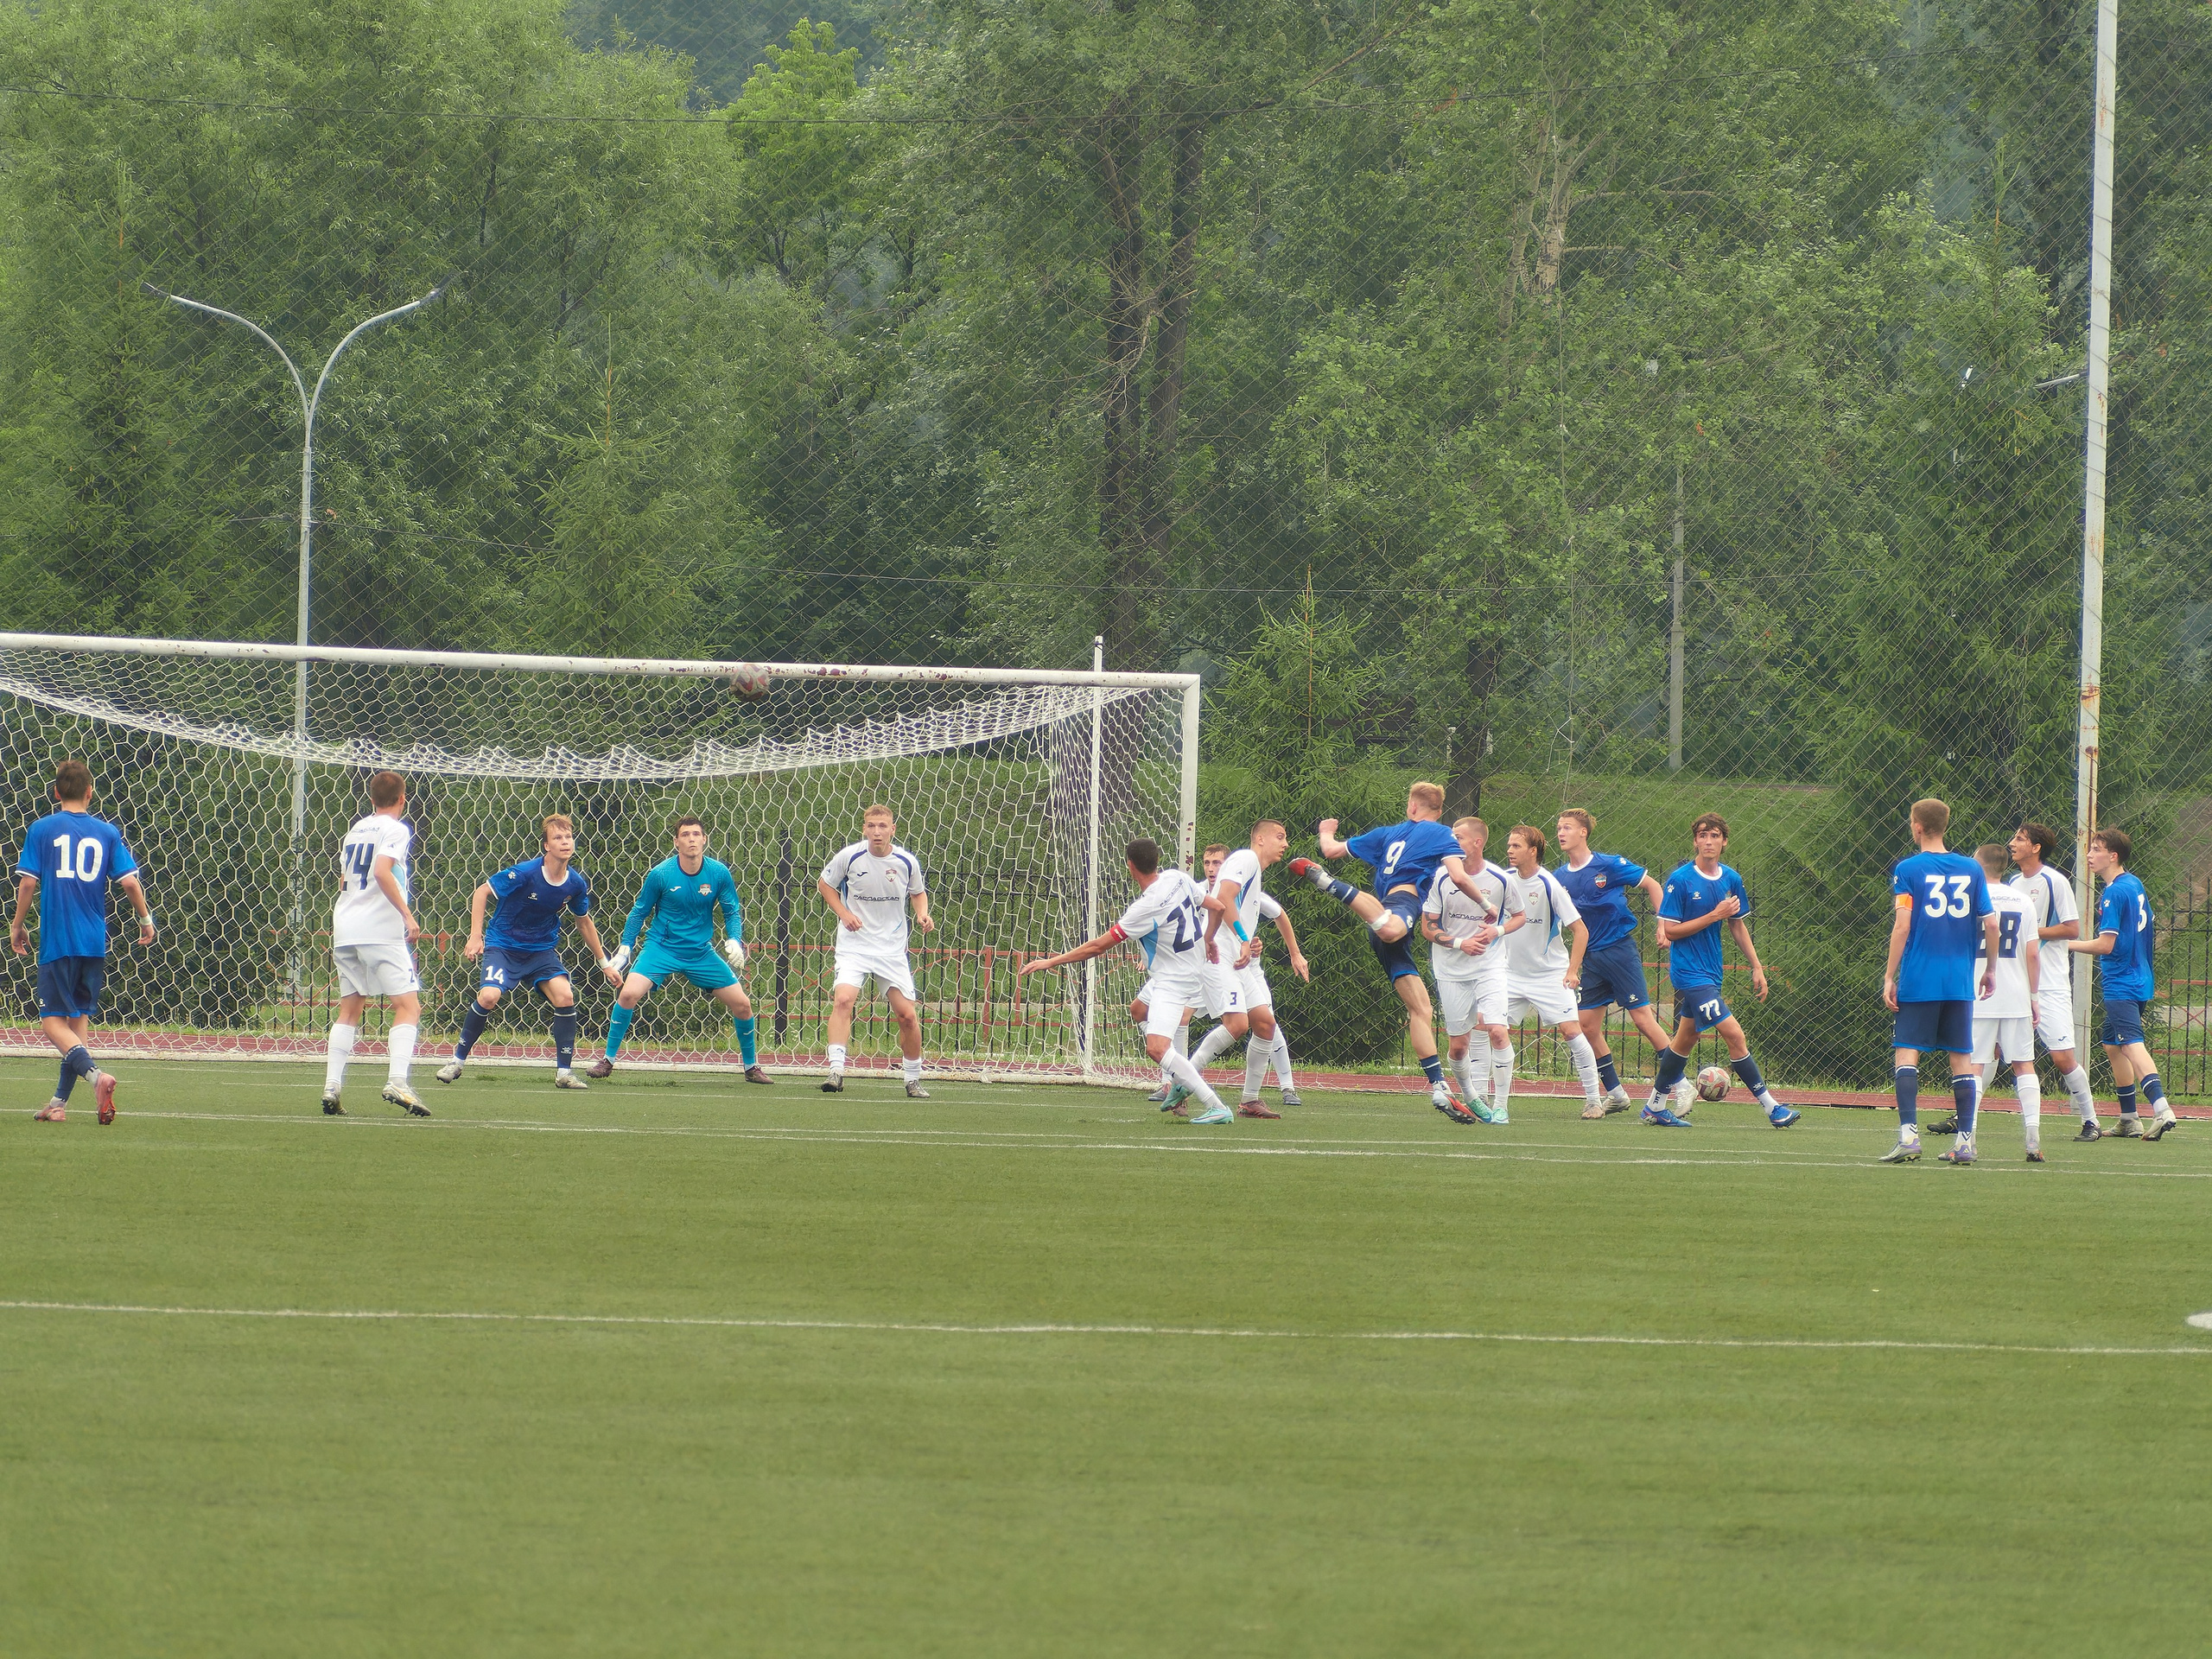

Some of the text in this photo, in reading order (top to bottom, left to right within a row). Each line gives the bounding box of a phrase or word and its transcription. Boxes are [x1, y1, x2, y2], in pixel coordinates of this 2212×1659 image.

[54, 834, 103, 881] 10
[1383, 840, 1406, 874] 9
[1924, 874, 1971, 918] 33
[485, 965, 504, 985] 14
[1230, 992, 1237, 1006] 3
[1699, 999, 1721, 1020] 77
